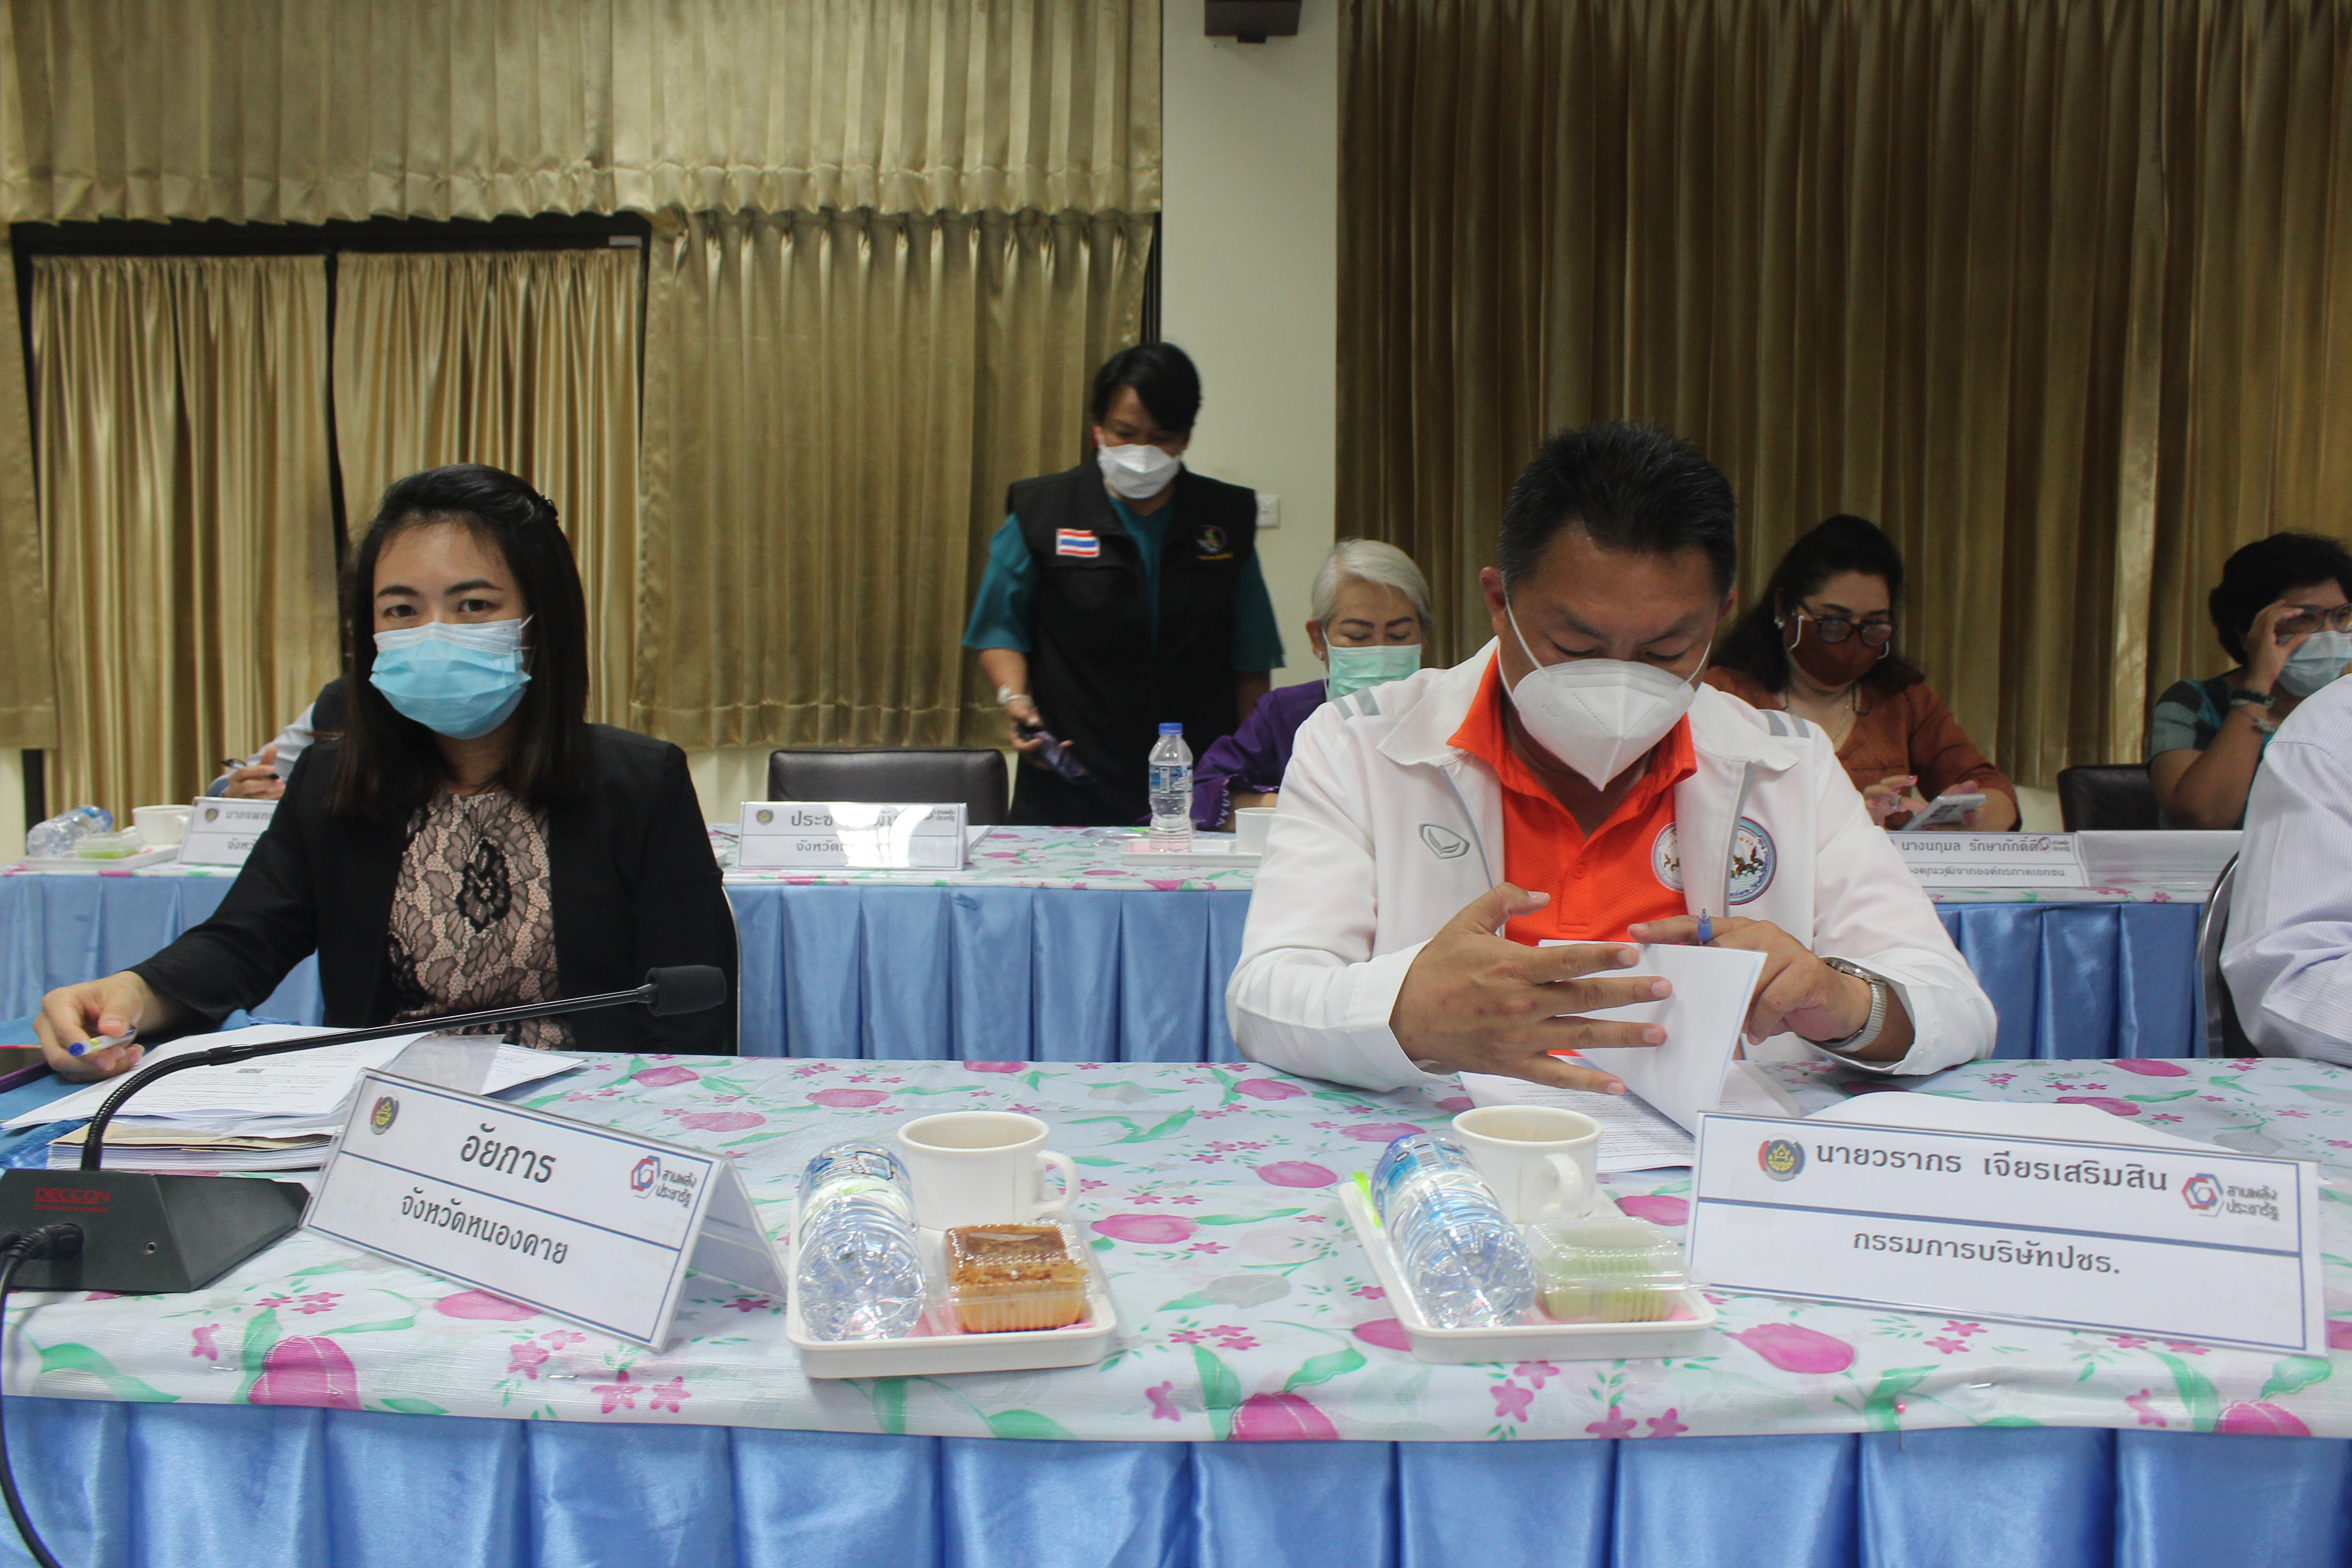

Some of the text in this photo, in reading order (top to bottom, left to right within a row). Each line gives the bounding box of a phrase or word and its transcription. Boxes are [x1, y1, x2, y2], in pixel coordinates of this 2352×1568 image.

[1901, 842, 1961, 853] นางนฤมล
[461, 1123, 557, 1183] อัยการ
[1816, 1144, 2167, 1191] นายวรากร เจียรเสริมสิน
[34, 1187, 111, 1202] DECCON
[402, 1186, 568, 1264] จังหวัดหนองคาย
[1853, 1232, 2120, 1274] กรรมการบริษัทปชร.
